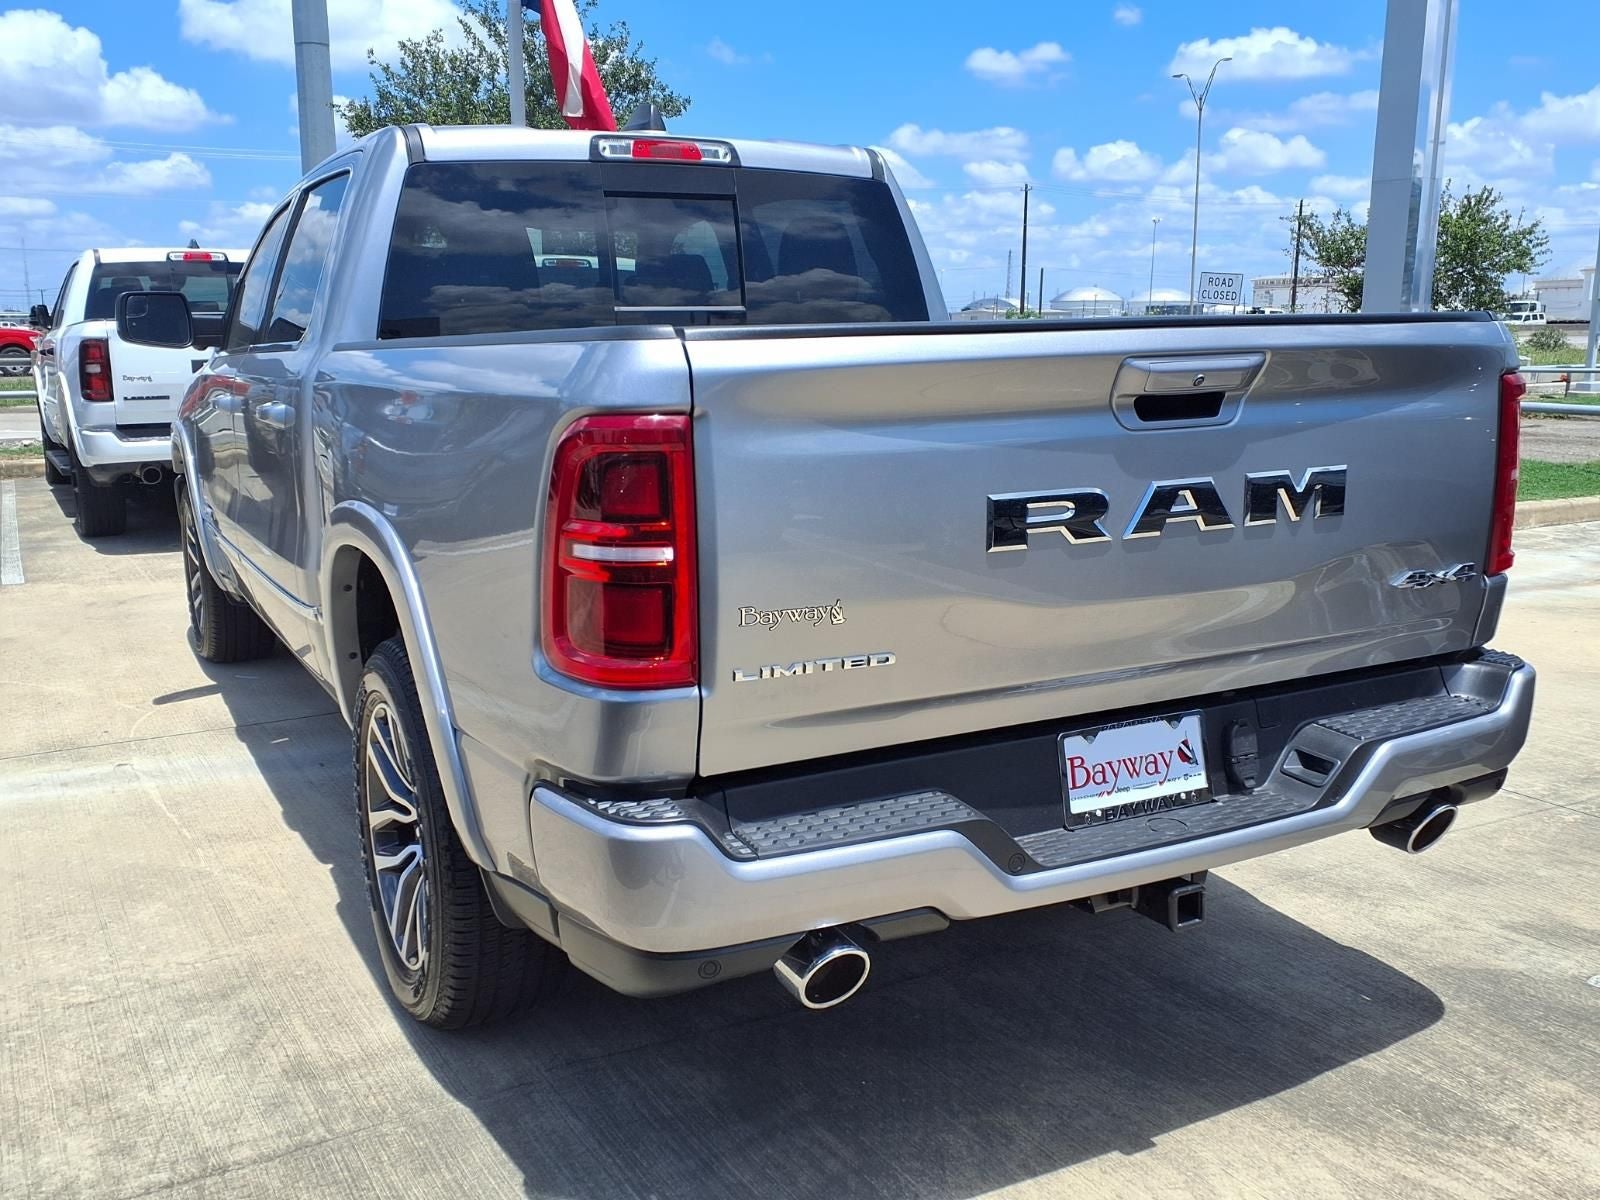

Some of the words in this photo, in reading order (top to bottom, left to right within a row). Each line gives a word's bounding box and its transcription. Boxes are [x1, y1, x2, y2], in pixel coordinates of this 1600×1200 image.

[1201, 289, 1238, 301] CLOSED
[1208, 276, 1234, 288] ROAD
[986, 465, 1347, 552] RAM
[738, 604, 832, 631] Bayway
[733, 651, 897, 682] LIMITED
[1067, 750, 1174, 796] Bayway
[1104, 792, 1177, 822] BAYWAY
